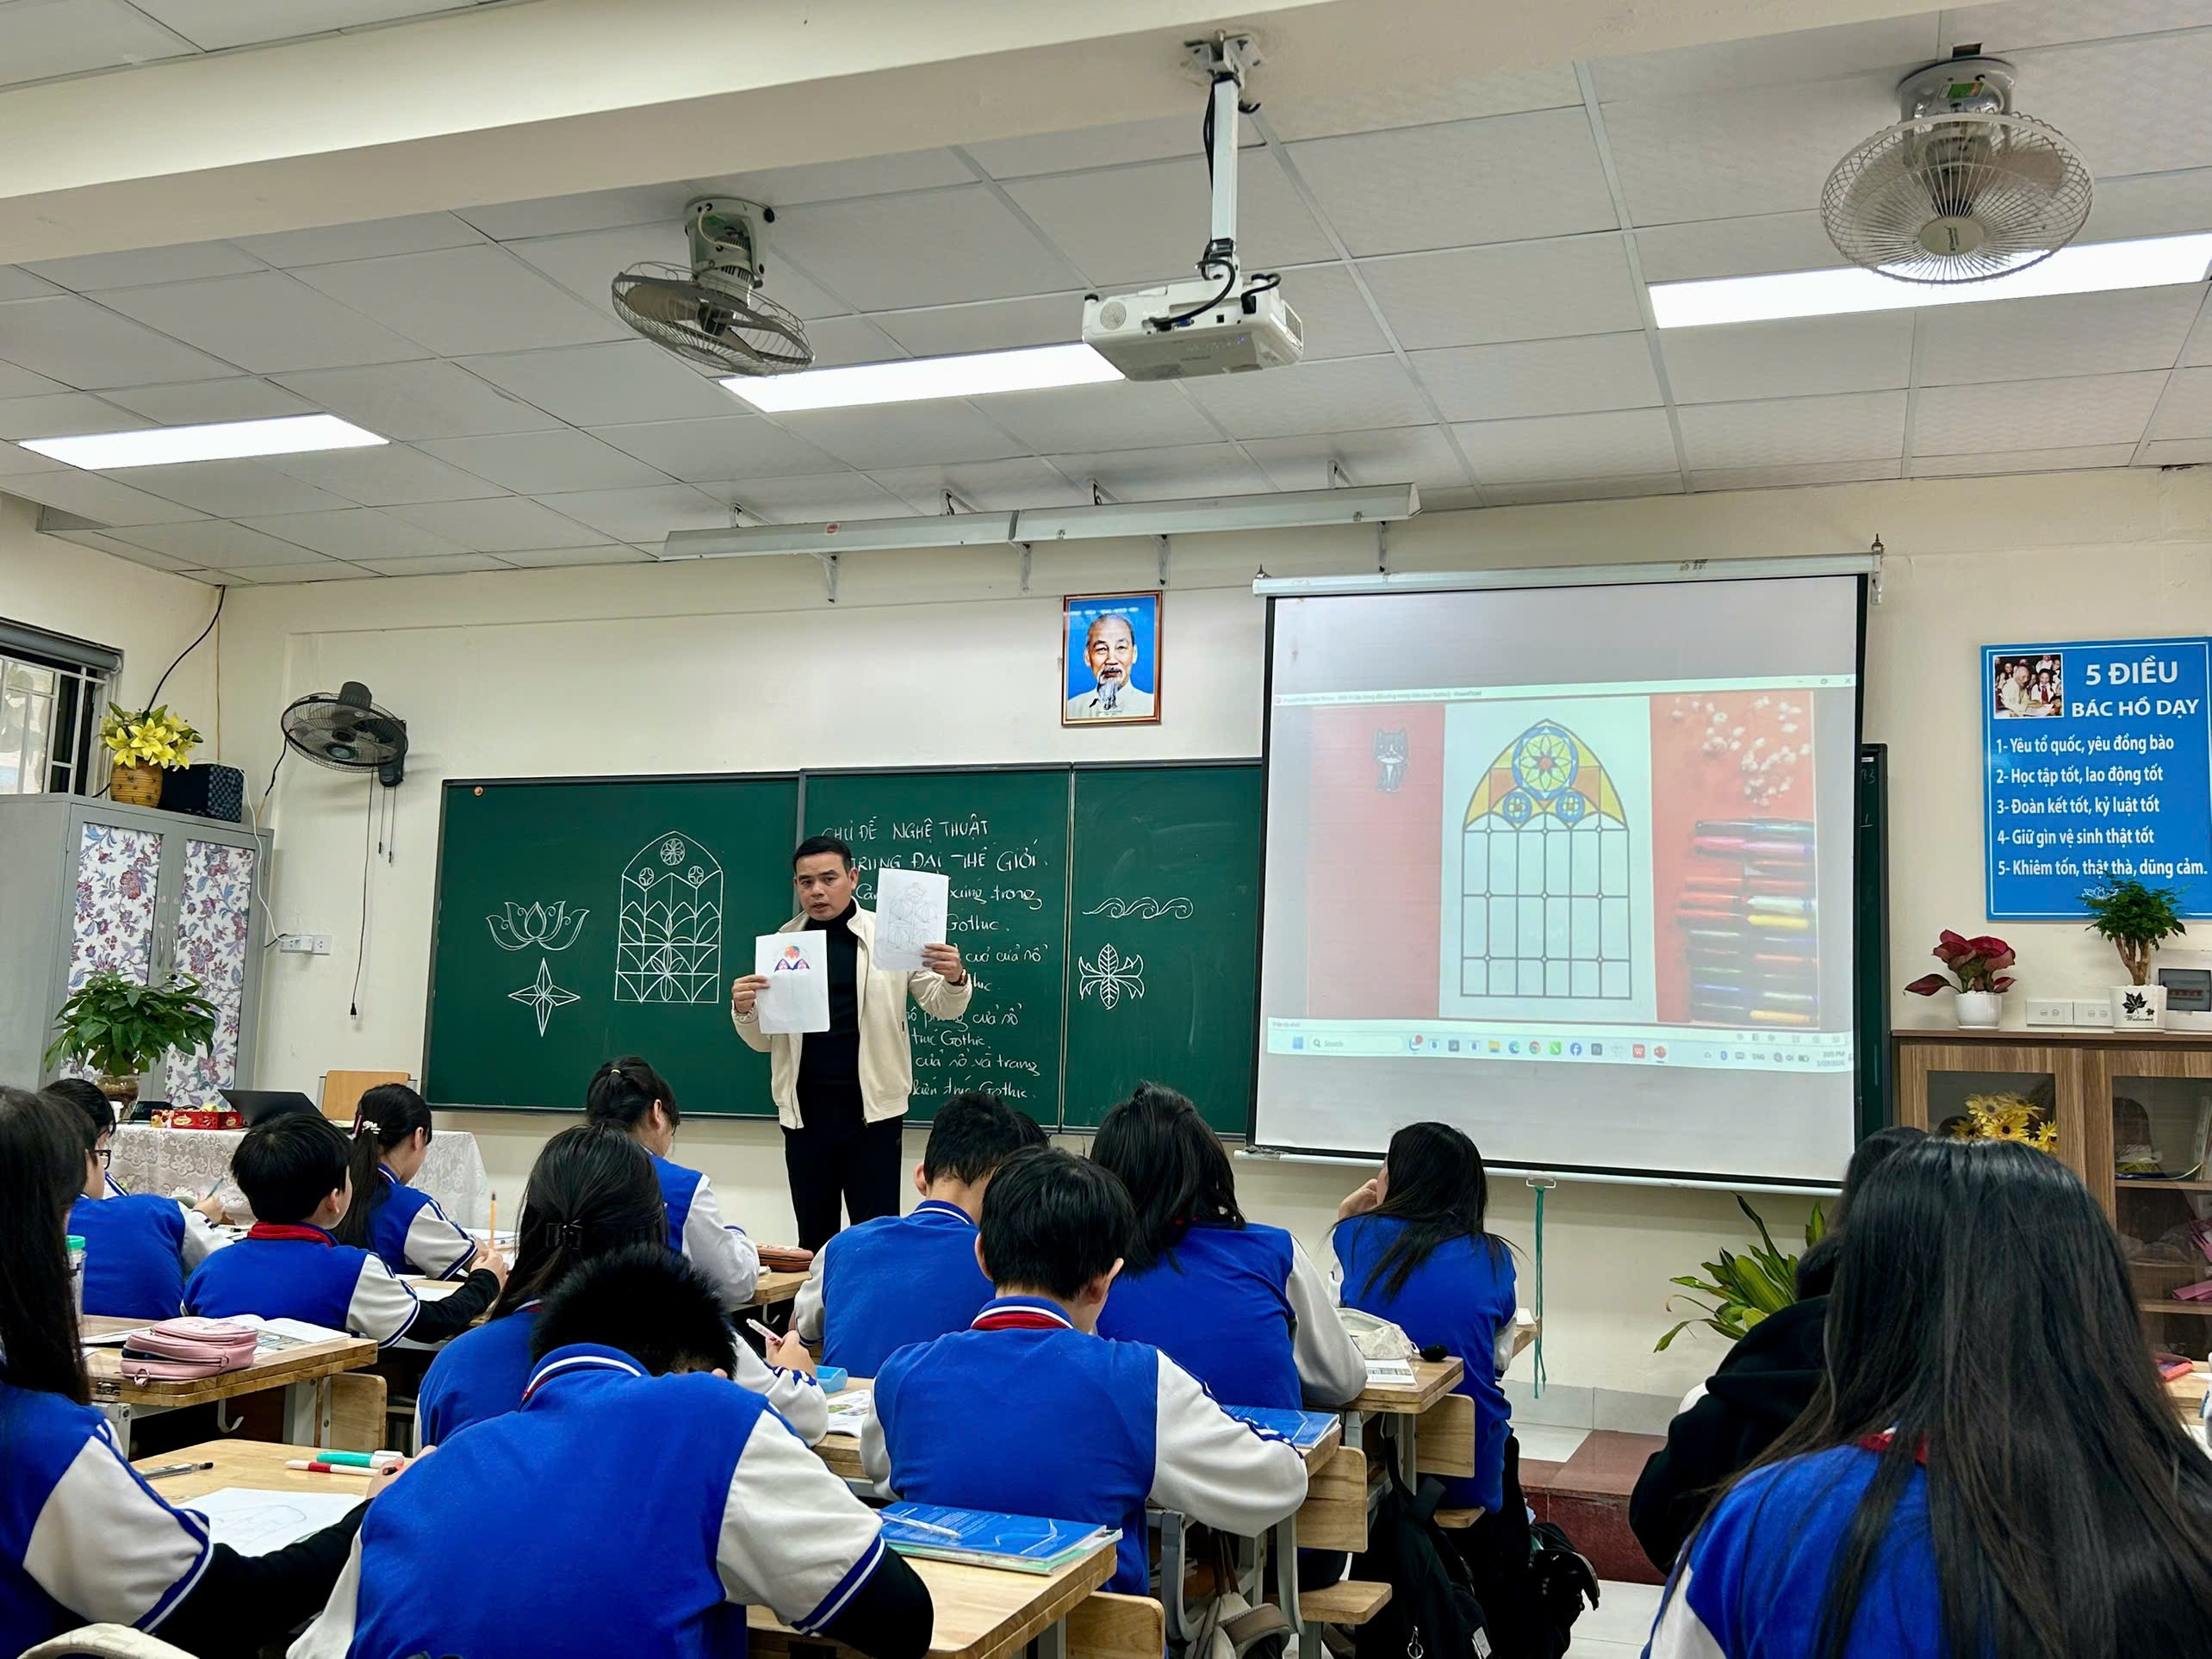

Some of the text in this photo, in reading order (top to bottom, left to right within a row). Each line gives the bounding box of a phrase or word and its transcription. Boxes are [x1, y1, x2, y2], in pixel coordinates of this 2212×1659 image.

[2085, 655, 2178, 686] 5 ĐIỀU
[2072, 696, 2199, 718] BÁC HỒ DẠY
[2010, 737, 2032, 753] Yêu
[2035, 734, 2047, 752] tổ
[2051, 734, 2085, 756] quốc,
[2087, 735, 2110, 755] yêu
[2113, 732, 2147, 755] đồng
[2149, 733, 2174, 750] bào
[2011, 768, 2035, 788] Học
[2037, 767, 2059, 787] tập
[2060, 765, 2083, 785] tốt,
[2085, 766, 2105, 782] lao
[2108, 766, 2141, 786] động
[2144, 762, 2164, 781] tốt
[2011, 798, 2045, 814] Đoàn
[2047, 795, 2068, 813] kết
[2070, 795, 2092, 816] tốt,
[2095, 796, 2110, 817] kỷ
[2113, 796, 2138, 817] luật
[2141, 793, 2160, 812] tốt
[892, 818, 933, 843] NGHỆ
[939, 813, 988, 840] THUẬT
[2012, 829, 2035, 844] Giữ
[2036, 828, 2056, 848] gìn
[2059, 828, 2074, 848] vệ
[2077, 828, 2103, 844] sinh
[2106, 828, 2133, 848] thật
[2134, 825, 2154, 844] tốt
[2013, 859, 2053, 876] Khiêm
[2055, 857, 2080, 878] tốn,
[2081, 859, 2109, 879] thật
[2111, 858, 2137, 878] thà,
[2139, 858, 2174, 879] dũng
[2176, 856, 2209, 875] cảm.
[991, 883, 1043, 910] trong
